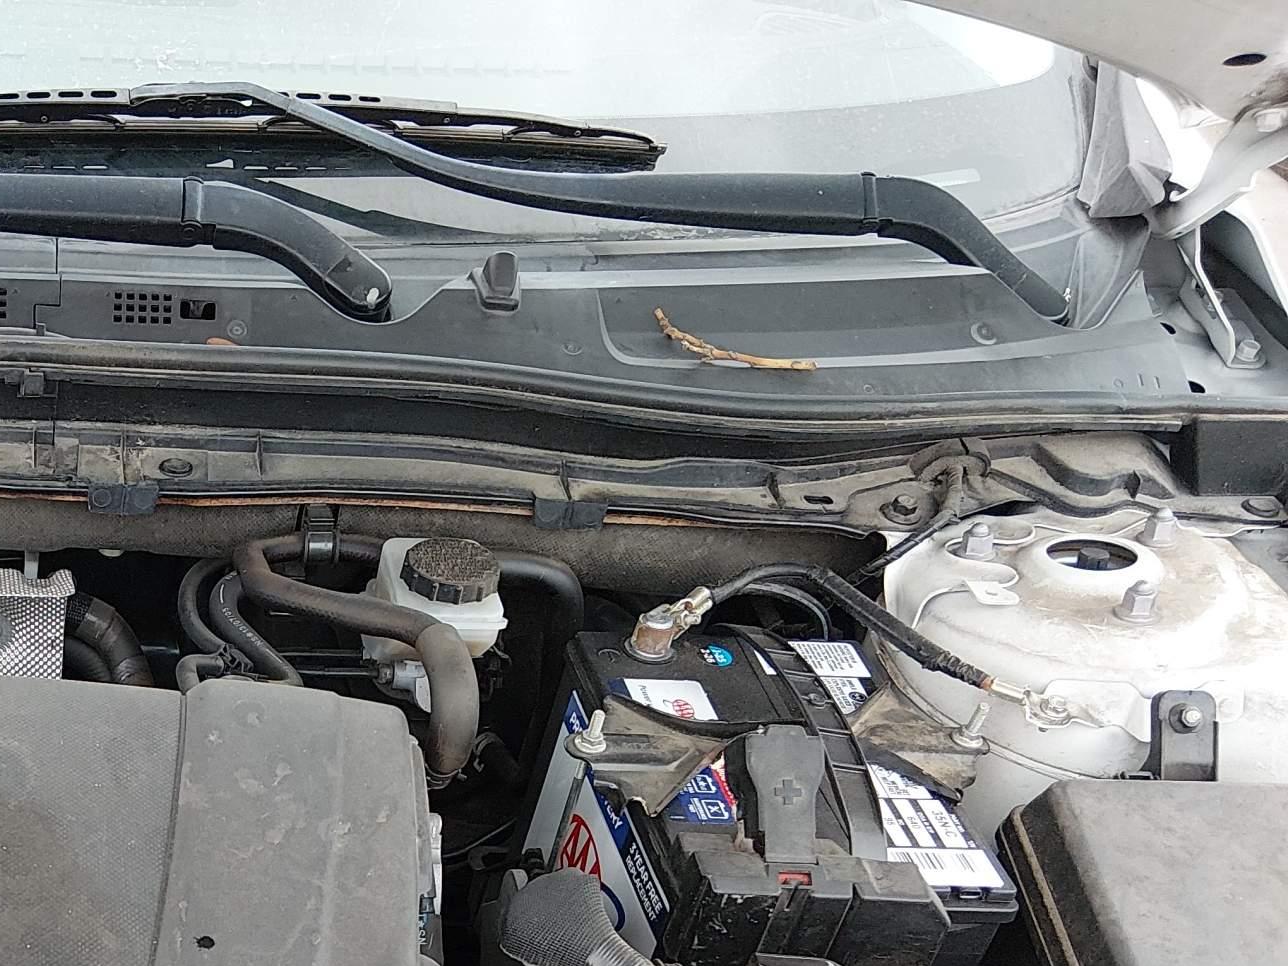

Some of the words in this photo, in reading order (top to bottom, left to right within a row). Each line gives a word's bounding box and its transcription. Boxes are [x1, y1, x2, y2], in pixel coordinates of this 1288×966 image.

[624, 854, 657, 922] REPLACEMENT
[632, 851, 650, 885] YEAR
[645, 882, 663, 915] FREE
